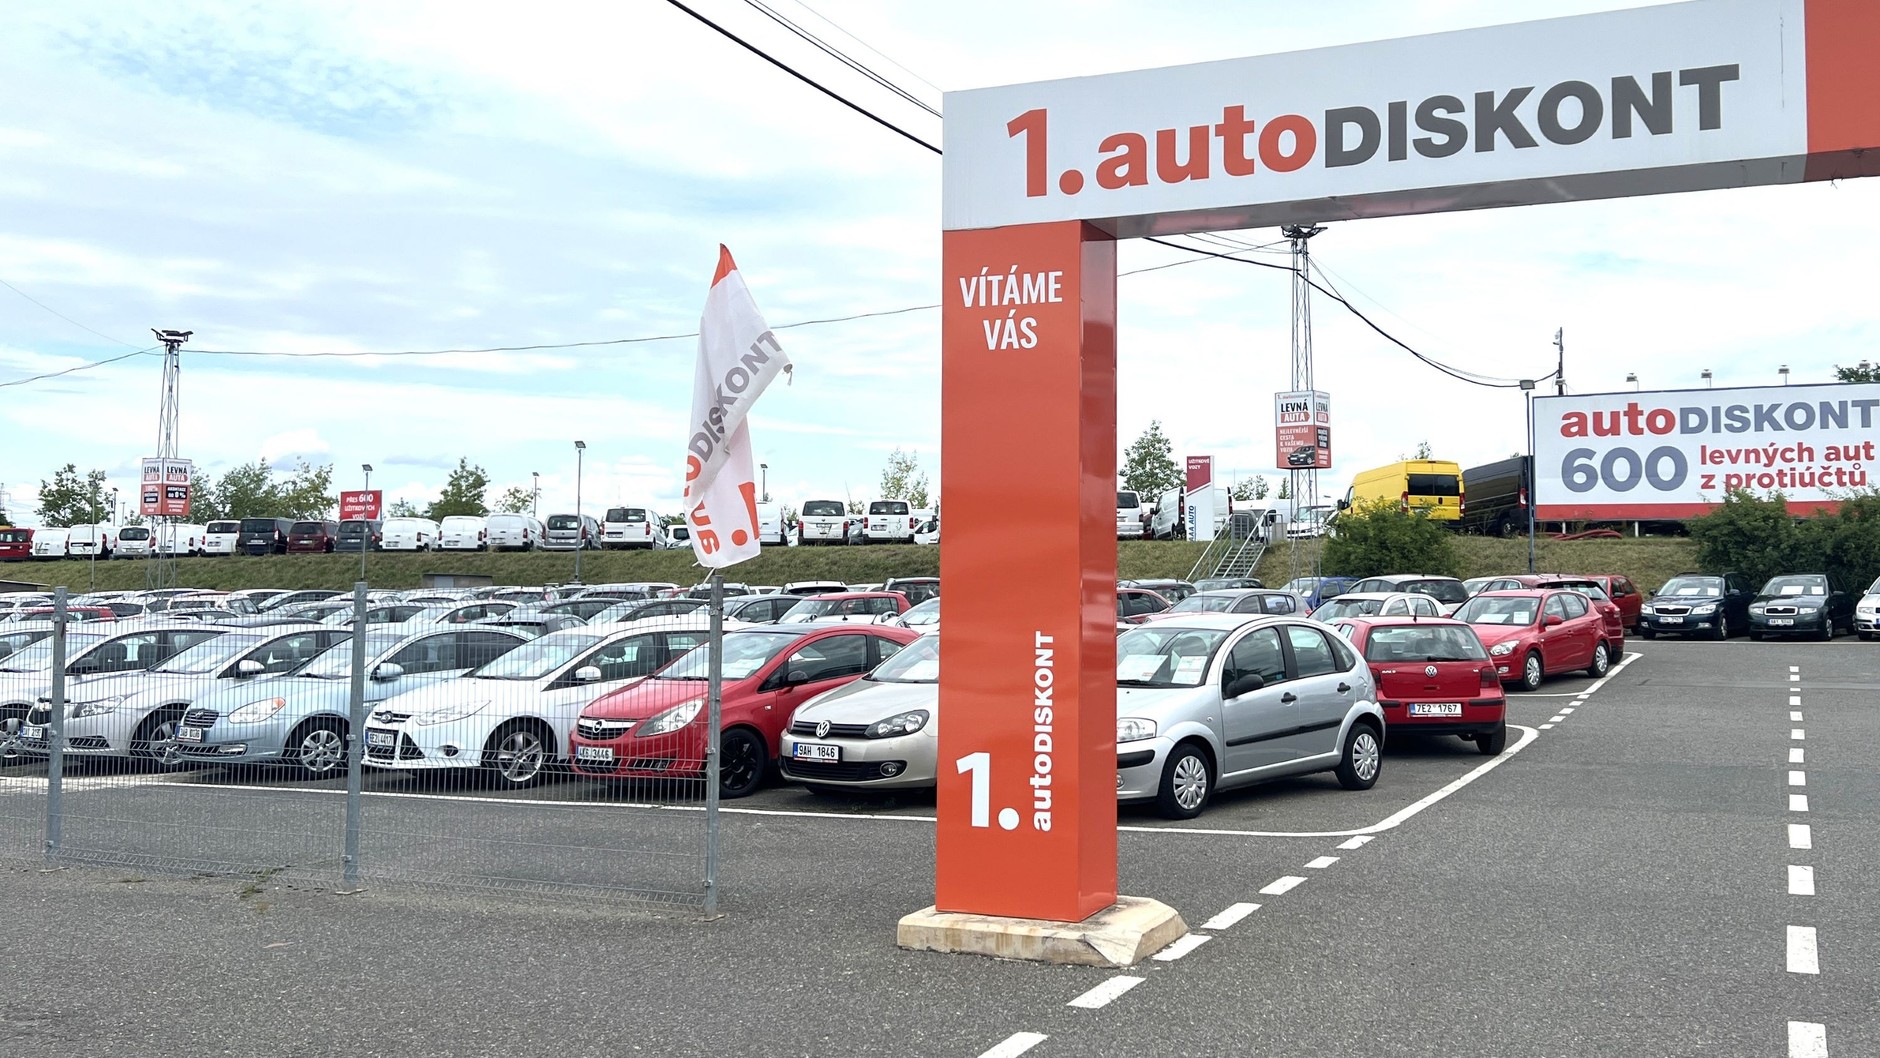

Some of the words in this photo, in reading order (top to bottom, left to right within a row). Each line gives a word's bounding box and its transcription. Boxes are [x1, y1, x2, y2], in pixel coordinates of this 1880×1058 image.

[959, 265, 1063, 308] VÍTÁME
[983, 309, 1038, 351] VÁS
[1281, 399, 1308, 413] LEVNÁ
[1284, 412, 1306, 422] AUTA
[1560, 399, 1880, 437] autoDISKONT
[166, 465, 188, 475] LEVNÁ
[1561, 445, 1688, 492] 600
[1701, 442, 1814, 467] levných
[1824, 441, 1875, 462] aut
[1701, 474, 1716, 489] z
[1724, 463, 1867, 494] protiúčtů
[1416, 704, 1432, 713] 7E2
[1438, 704, 1458, 713] 1767
[1029, 630, 1054, 832] autoDISKONT
[798, 744, 812, 757] 9AH
[816, 746, 836, 758] 1846
[956, 752, 1020, 830] 1.
